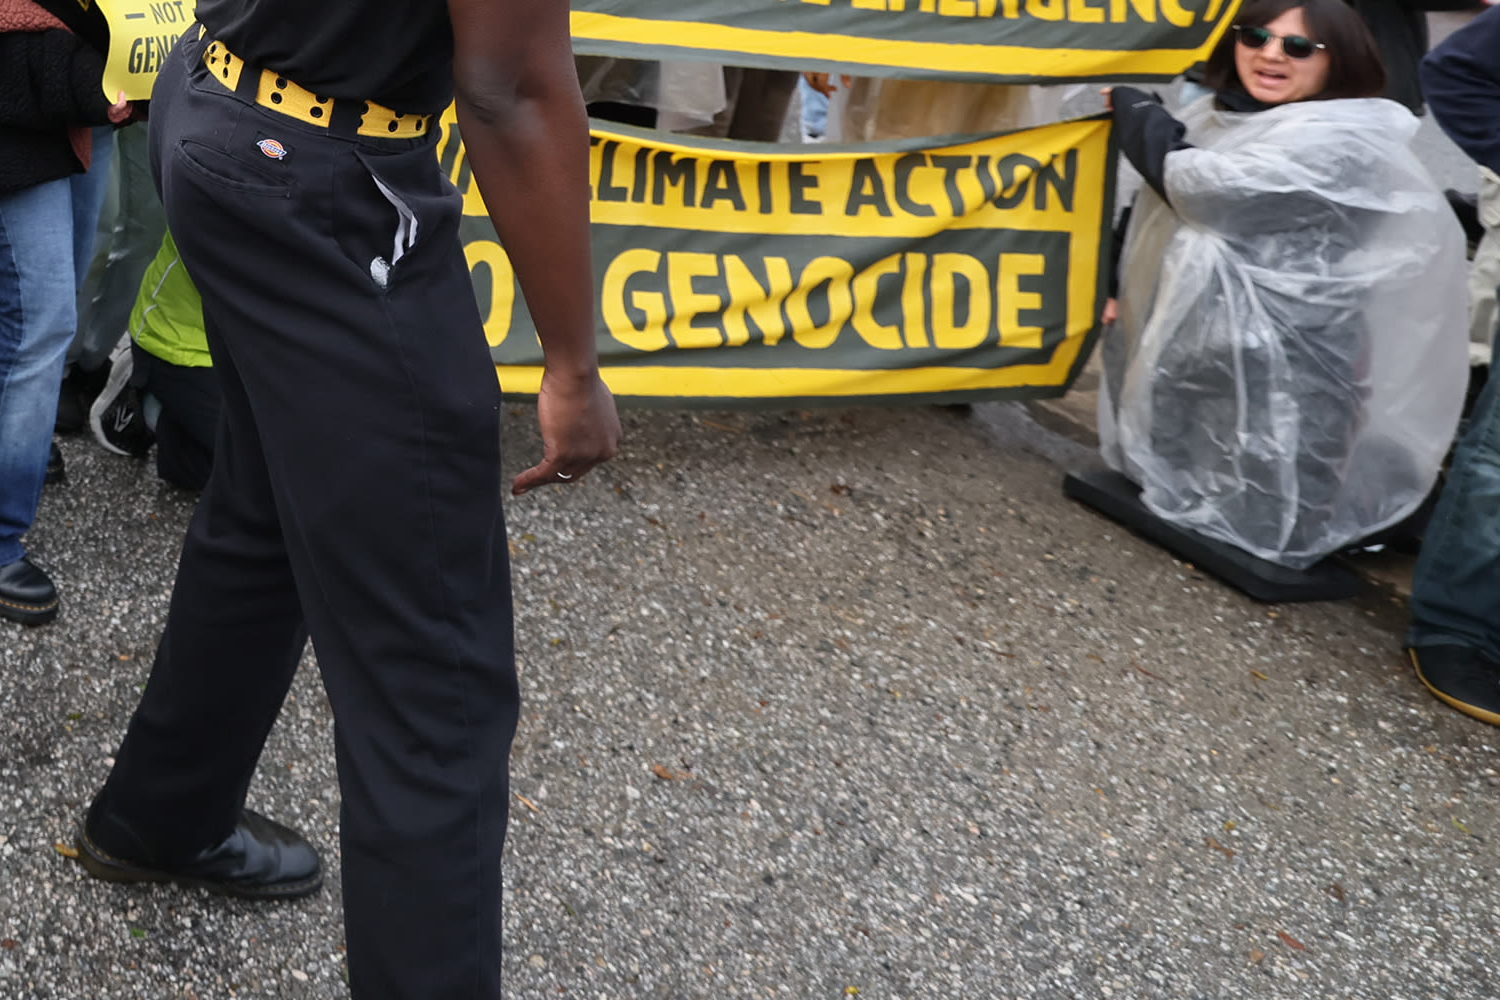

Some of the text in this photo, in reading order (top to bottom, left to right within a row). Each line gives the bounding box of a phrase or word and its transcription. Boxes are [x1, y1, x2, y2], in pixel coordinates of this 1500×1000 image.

[149, 0, 186, 25] NOT
[590, 137, 1078, 217] LIMATE ACTION
[601, 248, 1046, 351] GENOCIDE
